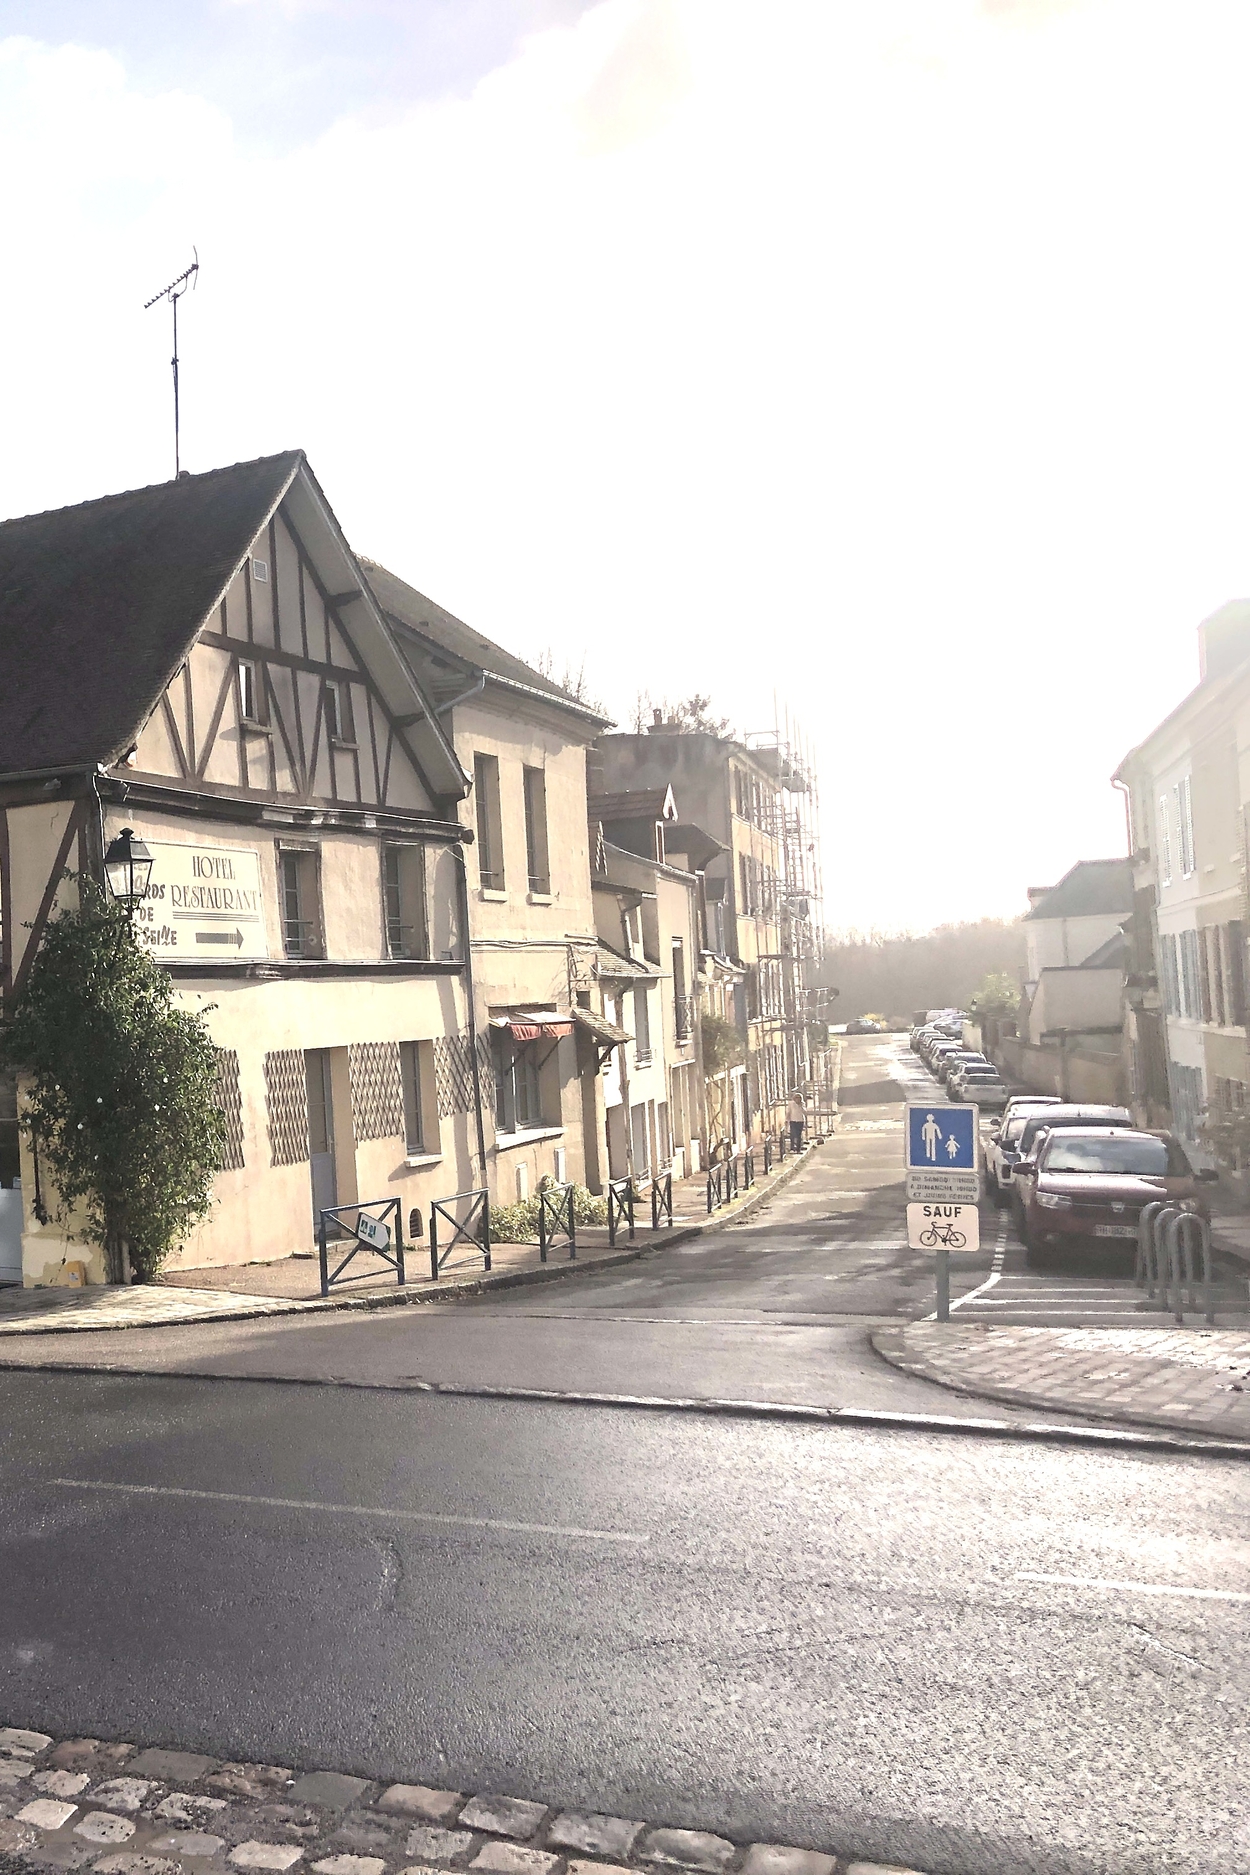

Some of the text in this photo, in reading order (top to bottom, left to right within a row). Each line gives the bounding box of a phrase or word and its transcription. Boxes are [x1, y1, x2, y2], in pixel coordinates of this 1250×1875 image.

[192, 855, 236, 880] HOTEL
[134, 875, 166, 900] ORDS
[170, 884, 258, 911] RESTAURANT
[139, 906, 154, 922] DE
[142, 925, 178, 946] SEINE
[923, 1205, 962, 1217] SAUF
